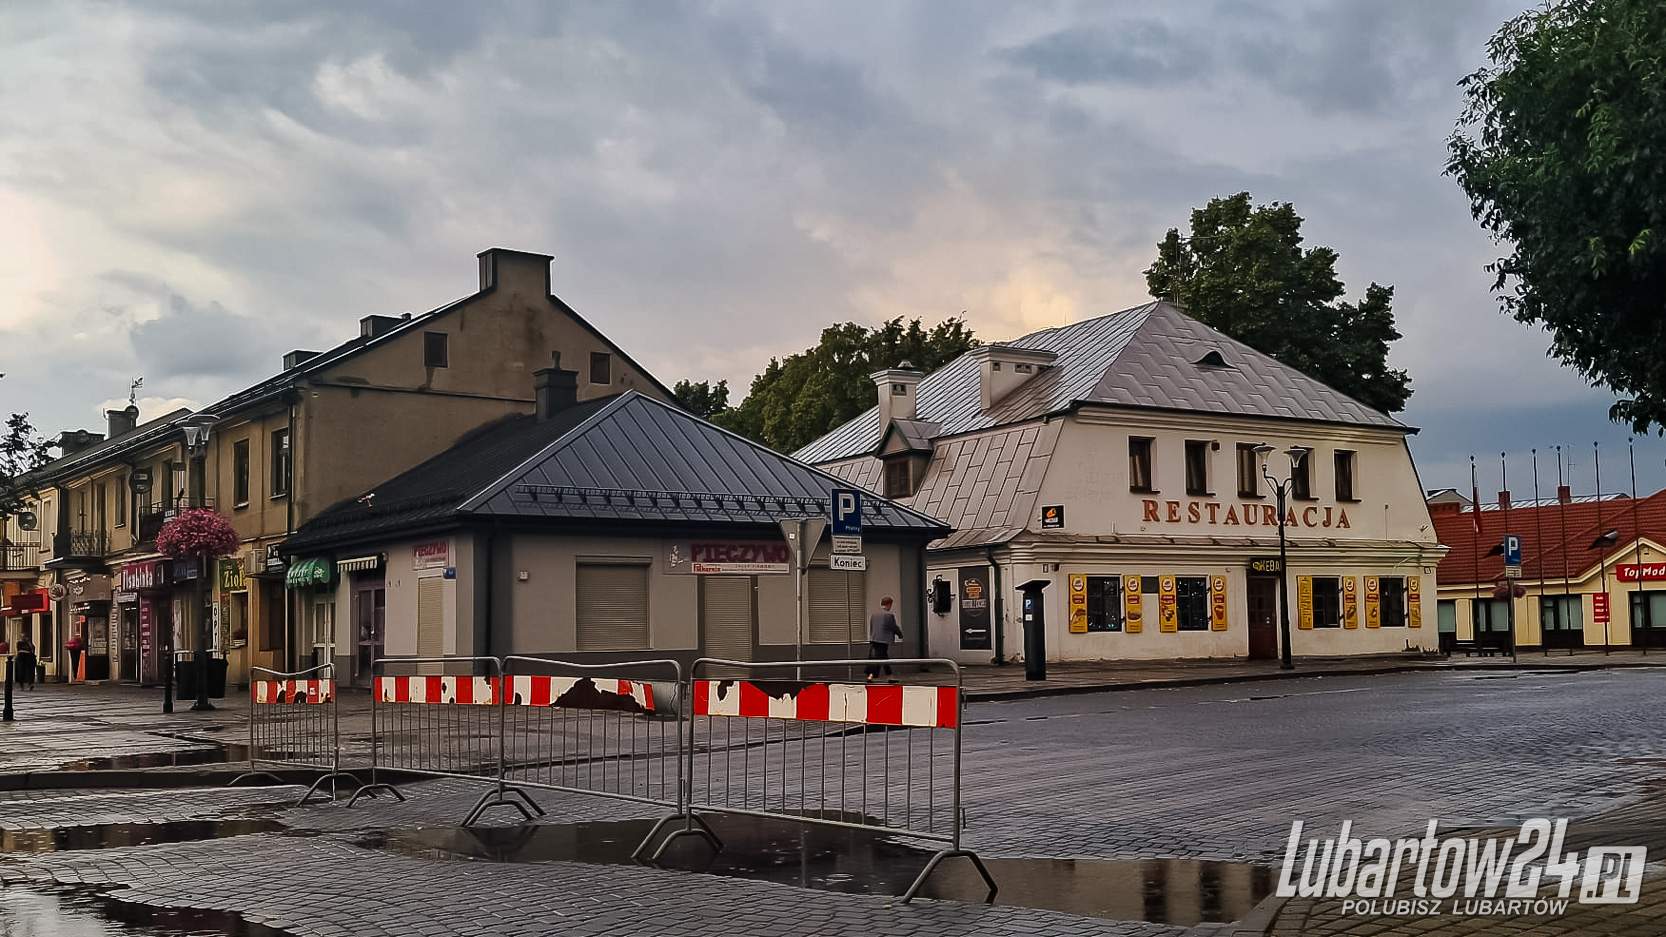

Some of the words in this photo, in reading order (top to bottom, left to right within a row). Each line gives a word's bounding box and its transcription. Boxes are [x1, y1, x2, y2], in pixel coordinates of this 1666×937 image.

[838, 493, 855, 521] P
[1142, 499, 1351, 529] RESTAURACJA
[691, 543, 789, 563] PIECZYWO
[1508, 536, 1518, 556] P
[834, 557, 862, 568] Koniec
[1025, 600, 1032, 609] P
